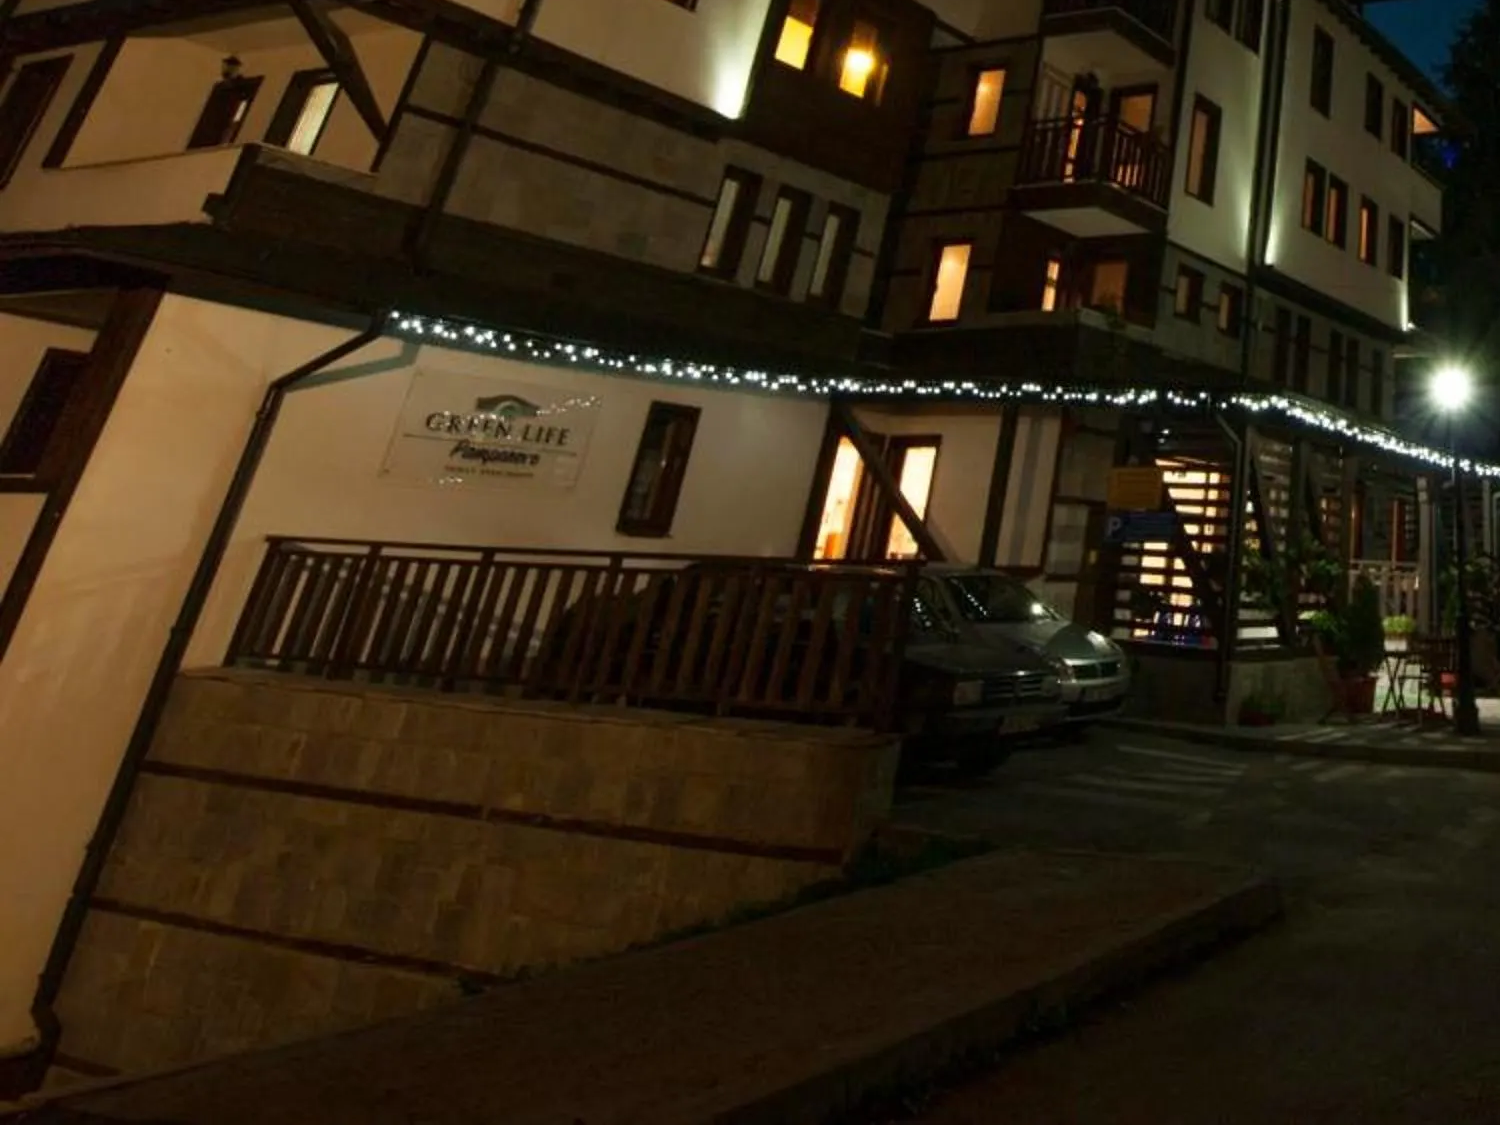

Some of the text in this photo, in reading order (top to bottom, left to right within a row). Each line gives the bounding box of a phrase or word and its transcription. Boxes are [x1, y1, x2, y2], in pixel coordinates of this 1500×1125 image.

[426, 412, 570, 445] GREEN LIFE
[1106, 516, 1121, 536] P
